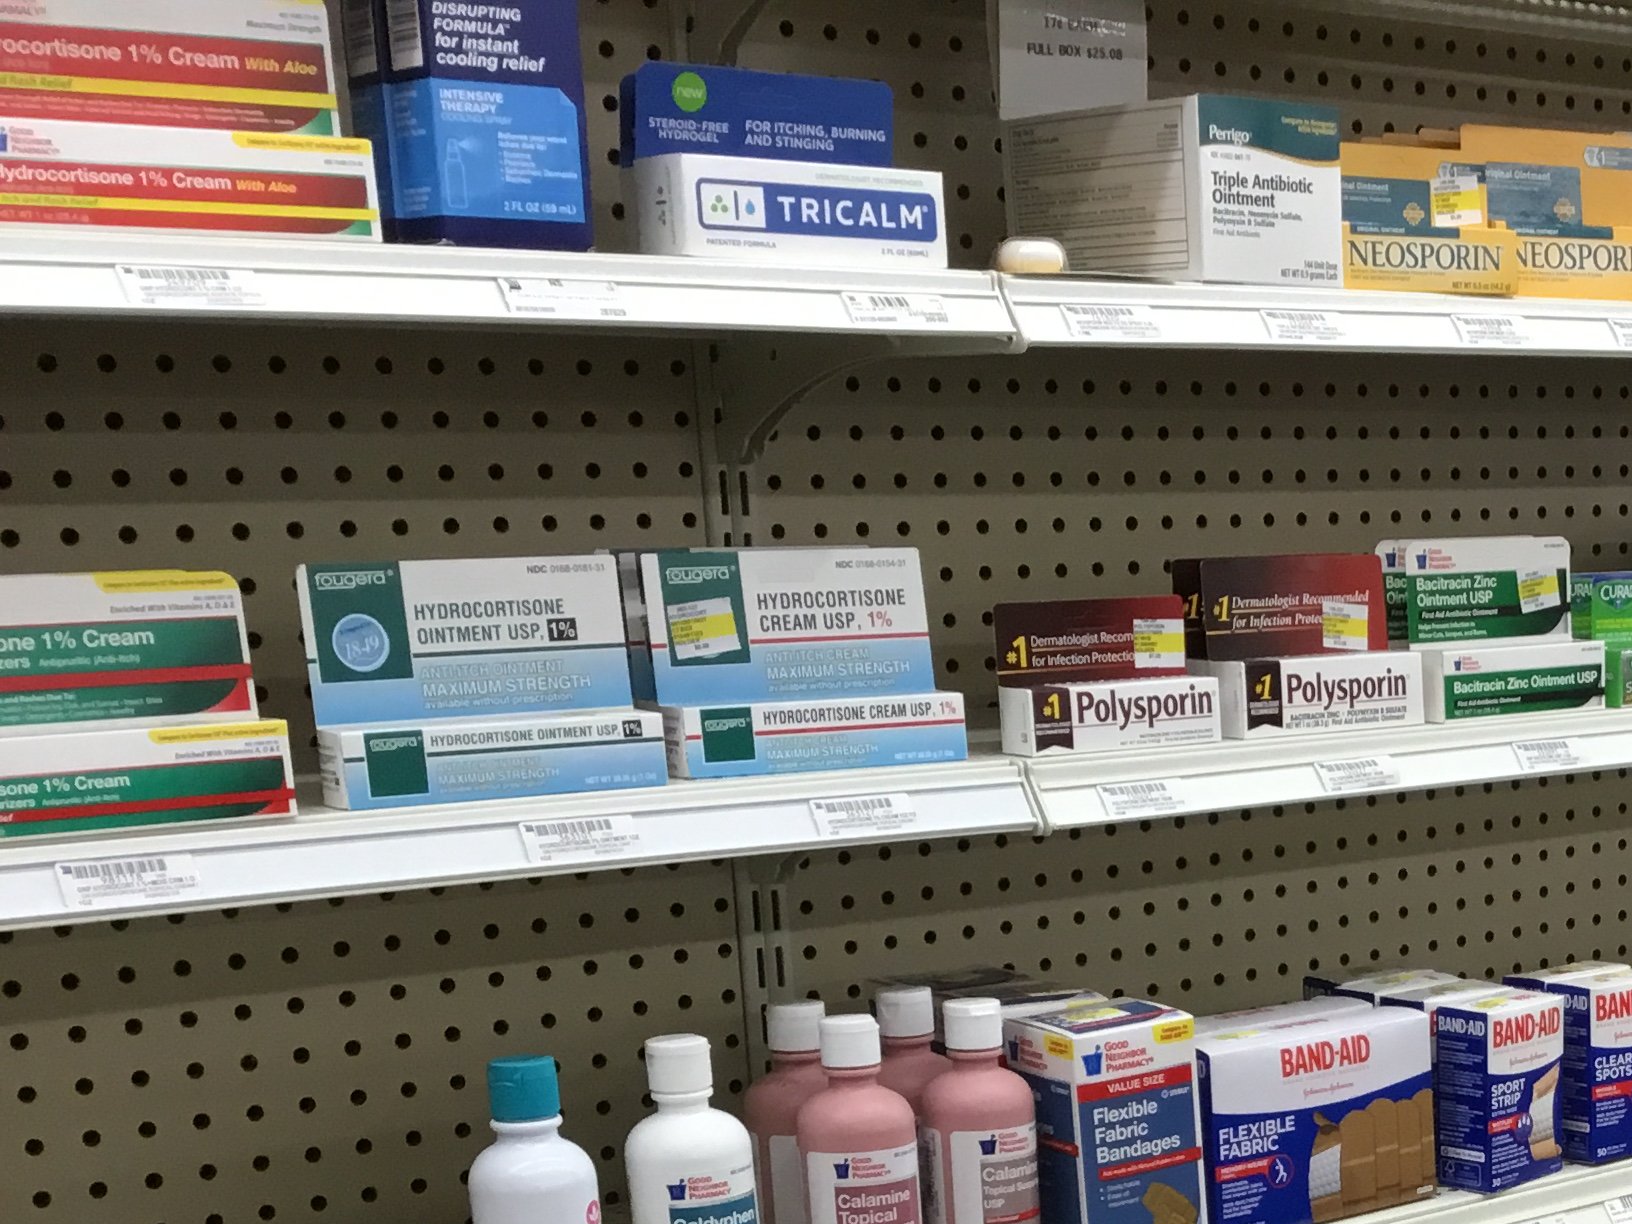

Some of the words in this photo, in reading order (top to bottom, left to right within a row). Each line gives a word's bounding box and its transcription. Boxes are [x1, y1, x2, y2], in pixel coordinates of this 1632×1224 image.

[432, 2, 521, 22] DISRUPTING
[435, 33, 458, 49] for
[462, 35, 519, 53] instant
[1027, 43, 1054, 57] FULL
[1058, 45, 1082, 59] BOX
[436, 50, 498, 72] cooling
[502, 56, 545, 73] relief
[648, 116, 729, 134] STEROID-FREE
[745, 119, 769, 134] FOR
[774, 122, 828, 138] ITCHING,
[831, 126, 886, 142] BURNING
[1209, 124, 1250, 145] Perrigo
[744, 134, 771, 147] AND
[775, 137, 834, 151] STINGING
[1211, 170, 1247, 190] Triple
[1252, 174, 1314, 195] Antibiotic
[1212, 190, 1275, 208] Ointment
[1348, 239, 1502, 271] NEOSPORIN
[316, 571, 385, 590] fougera
[1416, 576, 1472, 593] Bacitracin
[1474, 574, 1497, 588] Zinc
[414, 598, 565, 622] HYDROCORTISONE
[757, 588, 906, 611] HYDROCORTISONE
[1417, 590, 1467, 607] Ointment
[1470, 590, 1493, 603] USP
[760, 612, 818, 632] CREAM
[823, 612, 862, 632] USP,
[867, 610, 893, 628] 1%
[417, 623, 503, 645] OINTMENT
[507, 622, 545, 641] USP,
[550, 621, 576, 639] 1%
[1287, 668, 1407, 712] Polysporin
[763, 707, 865, 725] HYDROCORTISONE
[869, 703, 907, 718] CREAM
[909, 702, 936, 717] USP,
[939, 700, 956, 714] 1%
[1077, 685, 1213, 731] Polysporin
[1493, 1006, 1560, 1049] BAND-AID
[1280, 1034, 1370, 1078] BAND-AID
[1106, 1079, 1138, 1094] VALUE
[1141, 1073, 1166, 1088] SIZE
[1093, 1099, 1158, 1126] Flexible
[1095, 1120, 1149, 1145] Fabric
[1219, 1115, 1296, 1146] FLEXIBLE
[1097, 1133, 1181, 1164] Bandages
[1220, 1135, 1279, 1160] FABRIC
[837, 1188, 911, 1211] Calamine
